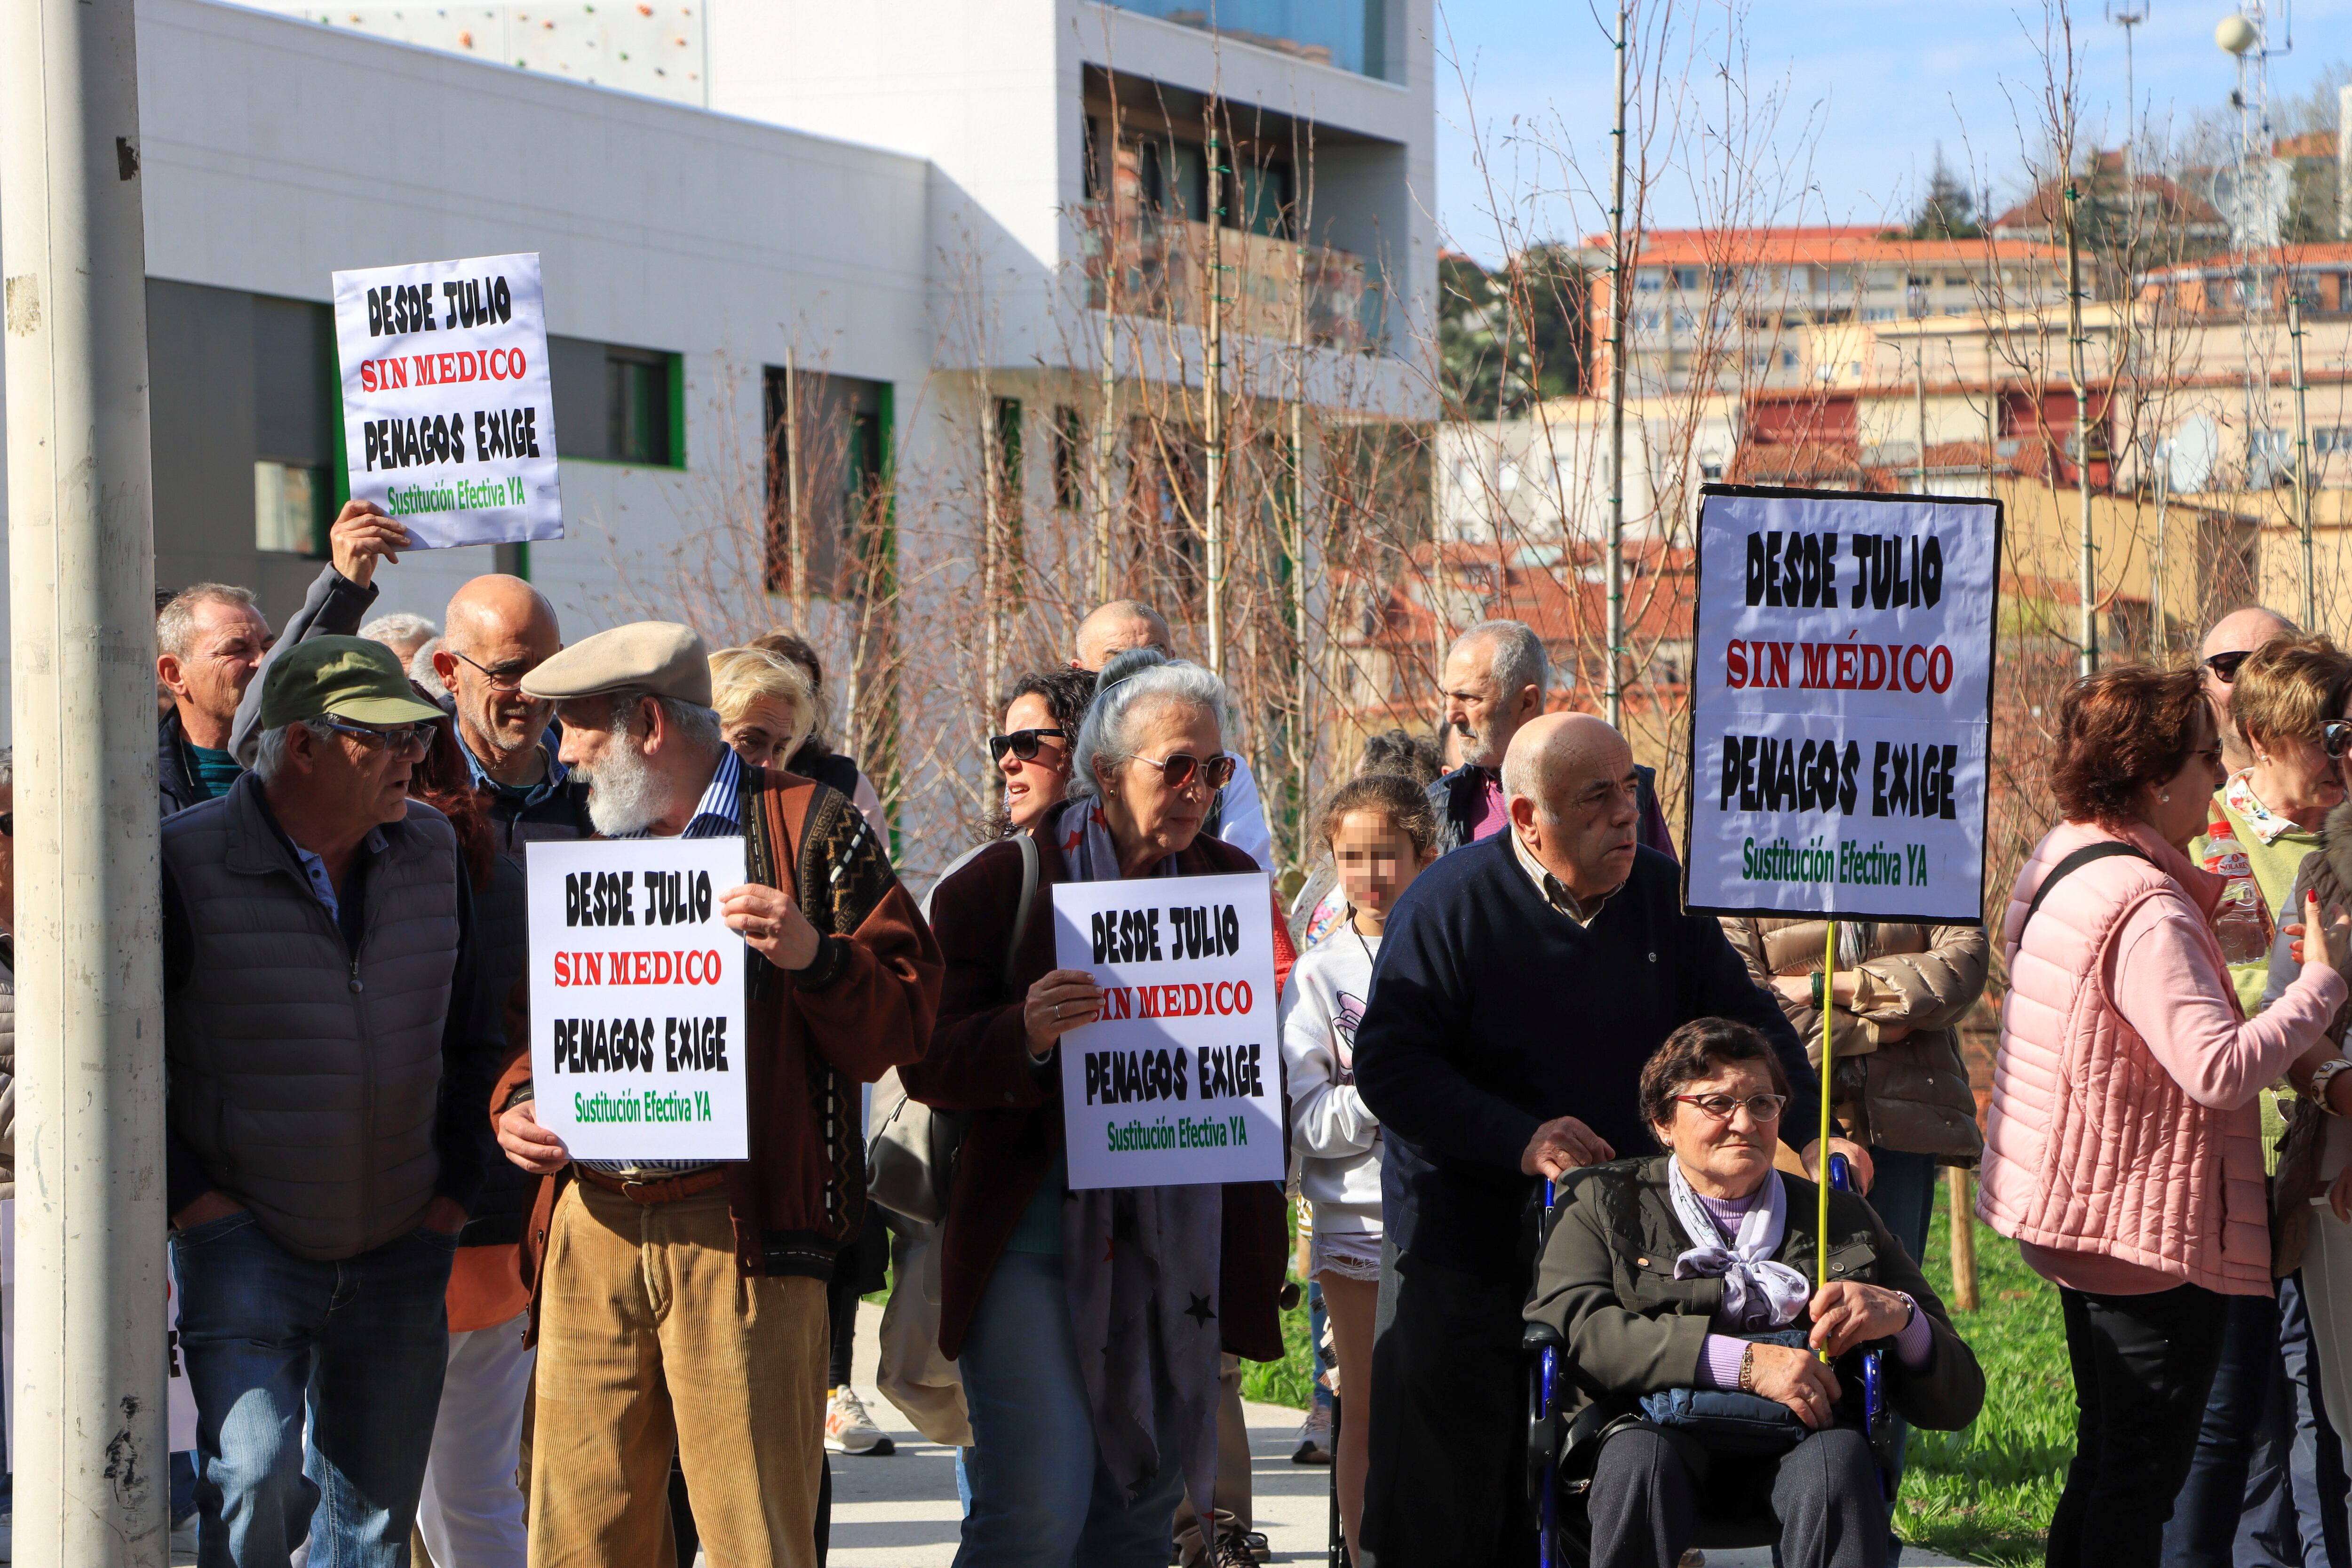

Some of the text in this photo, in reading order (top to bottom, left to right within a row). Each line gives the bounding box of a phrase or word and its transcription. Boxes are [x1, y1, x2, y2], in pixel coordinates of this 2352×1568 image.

[368, 277, 510, 336] DESDE JULIO
[361, 348, 526, 392] SIN MEDICO
[365, 408, 540, 471] PENAGOS EXIGE
[388, 477, 525, 516] Sustitución Efectiva YA
[1746, 532, 1943, 610] DESDE JULIO
[1728, 630, 1952, 693] SIN MÉDICO
[1720, 736, 1957, 820] PENAGOS EXIGE
[1743, 836, 1927, 886] Sustitución Efectiva YA
[566, 871, 711, 926] DESDE JULIO
[1092, 905, 1239, 964] DESDE JULIO
[555, 950, 722, 987] SIN MEDICO
[1090, 980, 1252, 1022] IN MEDICO
[555, 1017, 728, 1073] PENAGOS EXIGE
[1085, 1044, 1263, 1106] PENAGOS EXIGE
[574, 1089, 712, 1122] Sustitución Efectiva YA
[1108, 1116, 1248, 1151] Sustitución Efectiva YA
[826, 1413, 844, 1434] N
